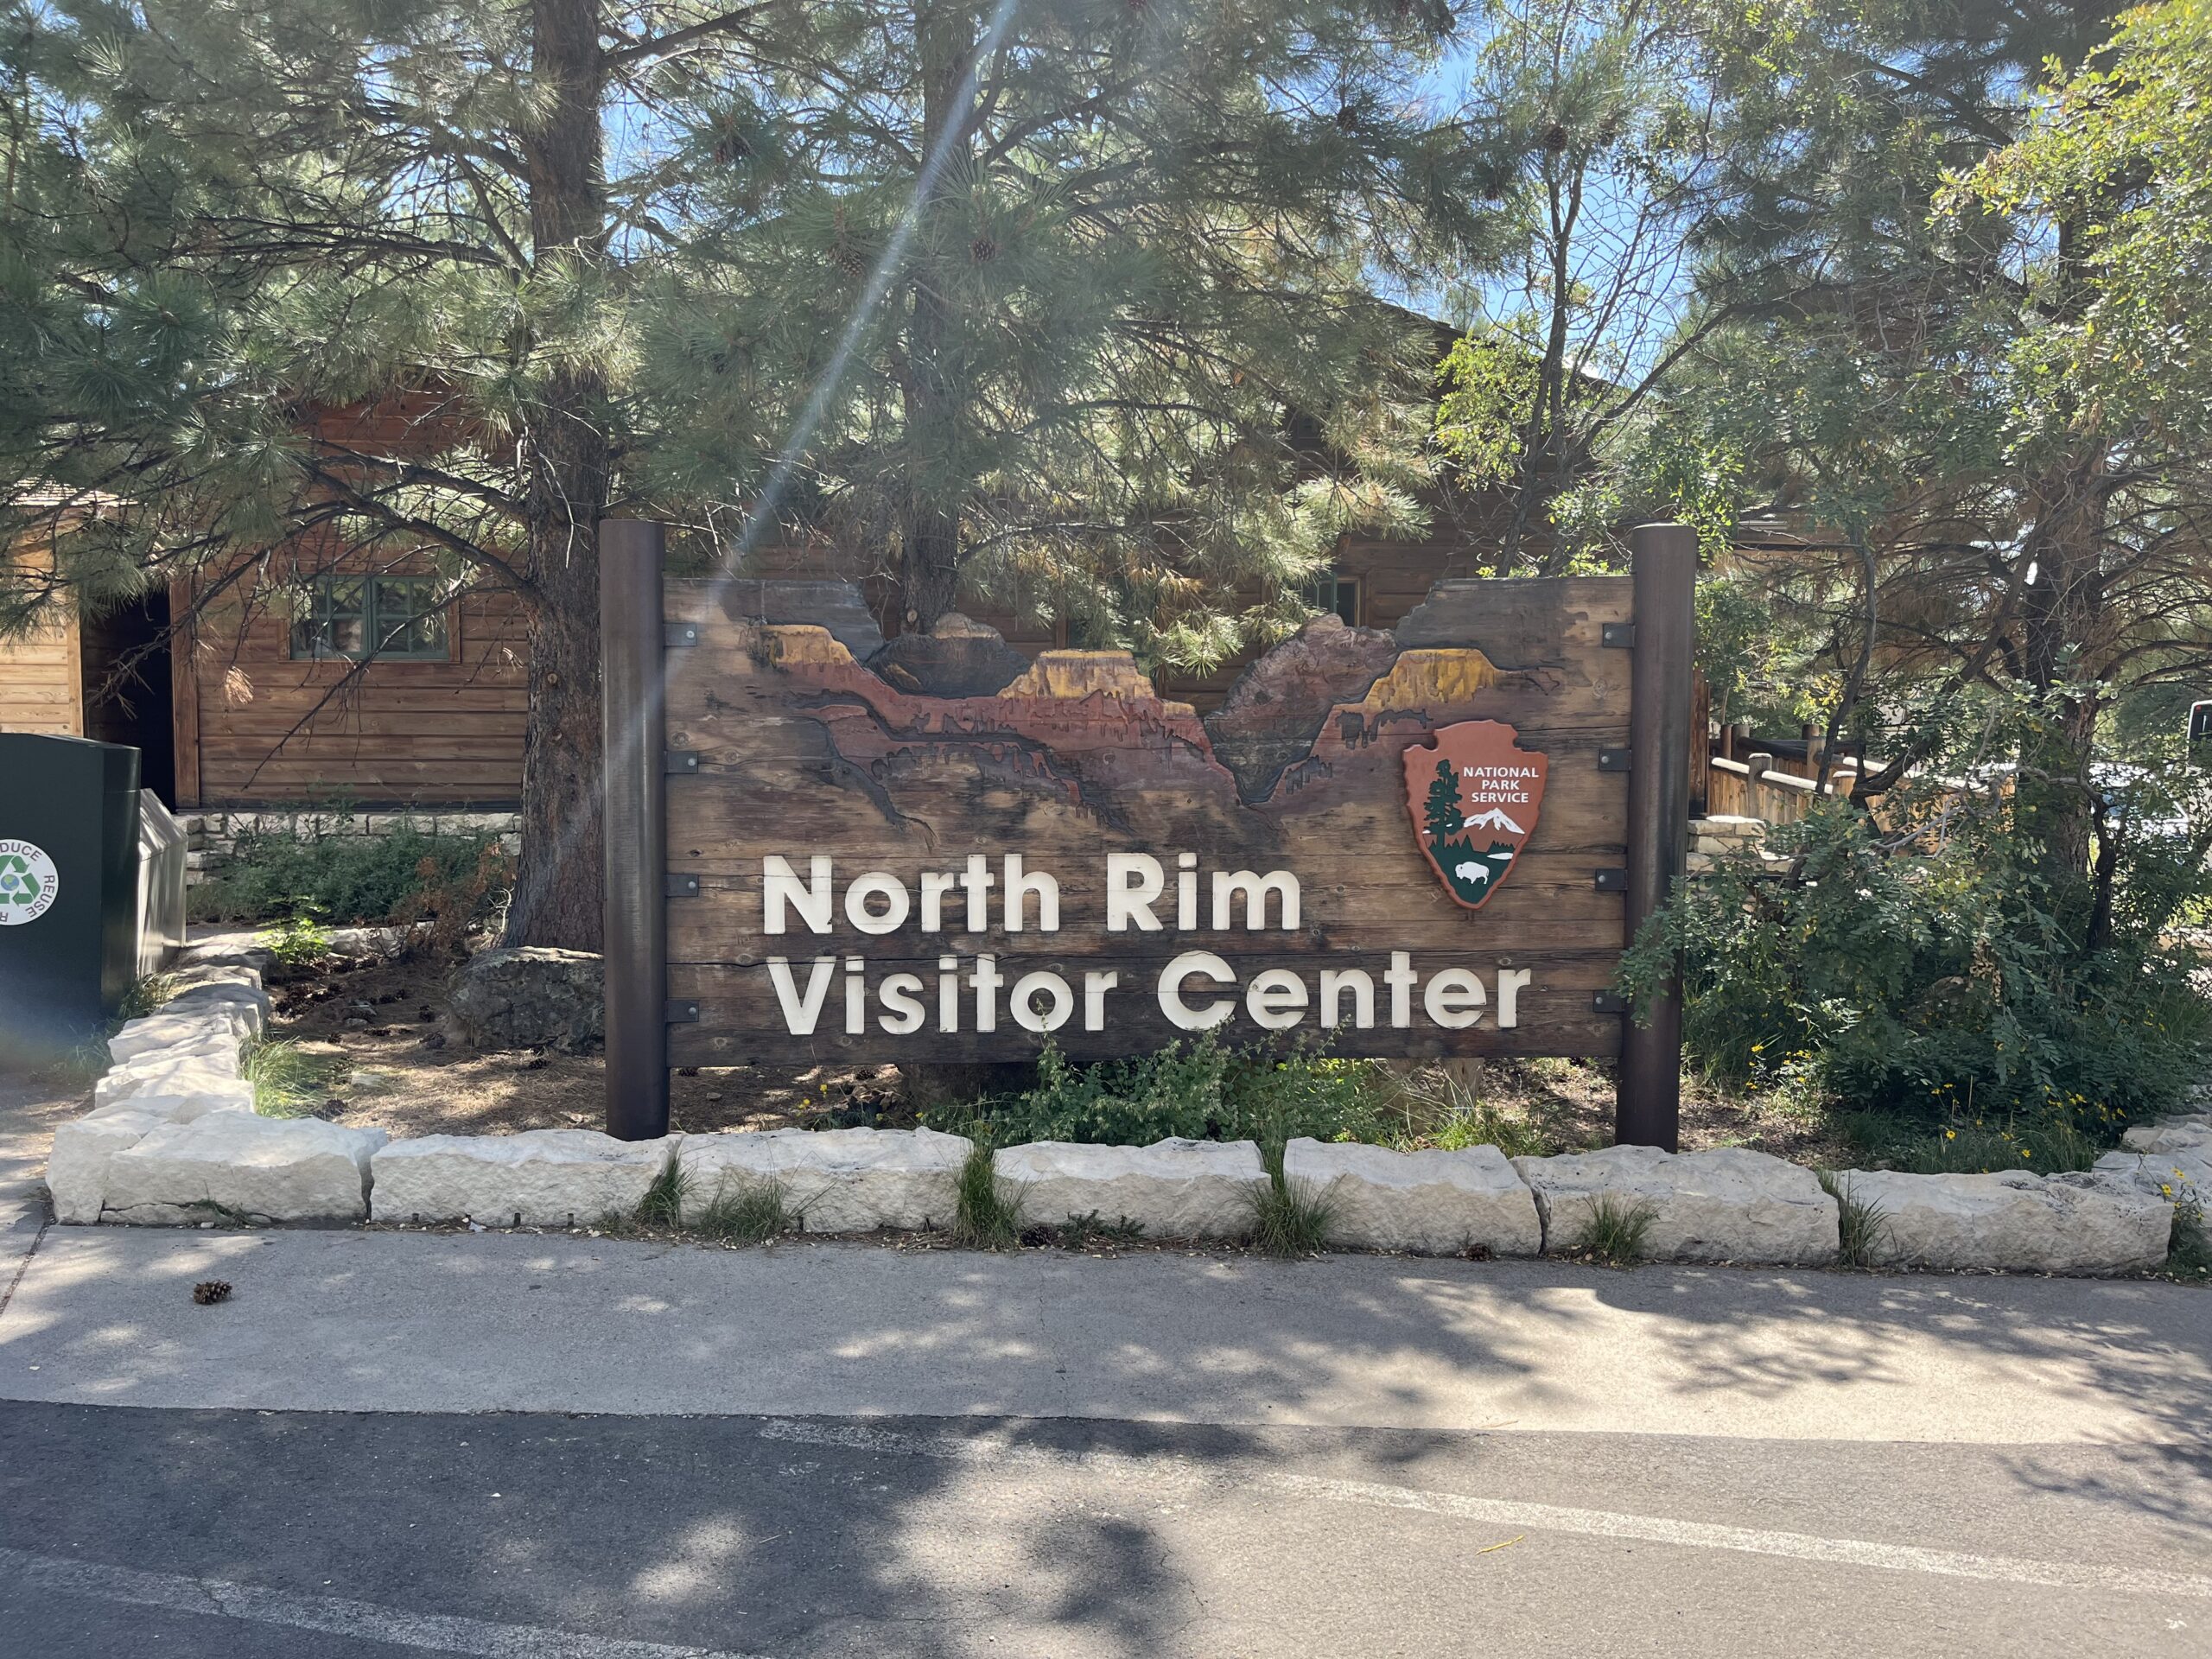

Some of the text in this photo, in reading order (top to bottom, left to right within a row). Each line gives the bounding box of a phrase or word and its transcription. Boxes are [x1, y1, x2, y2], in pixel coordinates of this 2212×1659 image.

[1463, 766, 1540, 778] NATIONAL
[1481, 779, 1520, 791] PARK
[1471, 791, 1529, 803] SERVICE
[0, 842, 42, 861] DUCE
[25, 874, 55, 918] REUSE
[762, 852, 1300, 935] North Rim
[766, 950, 1531, 1035] Visitor Center
